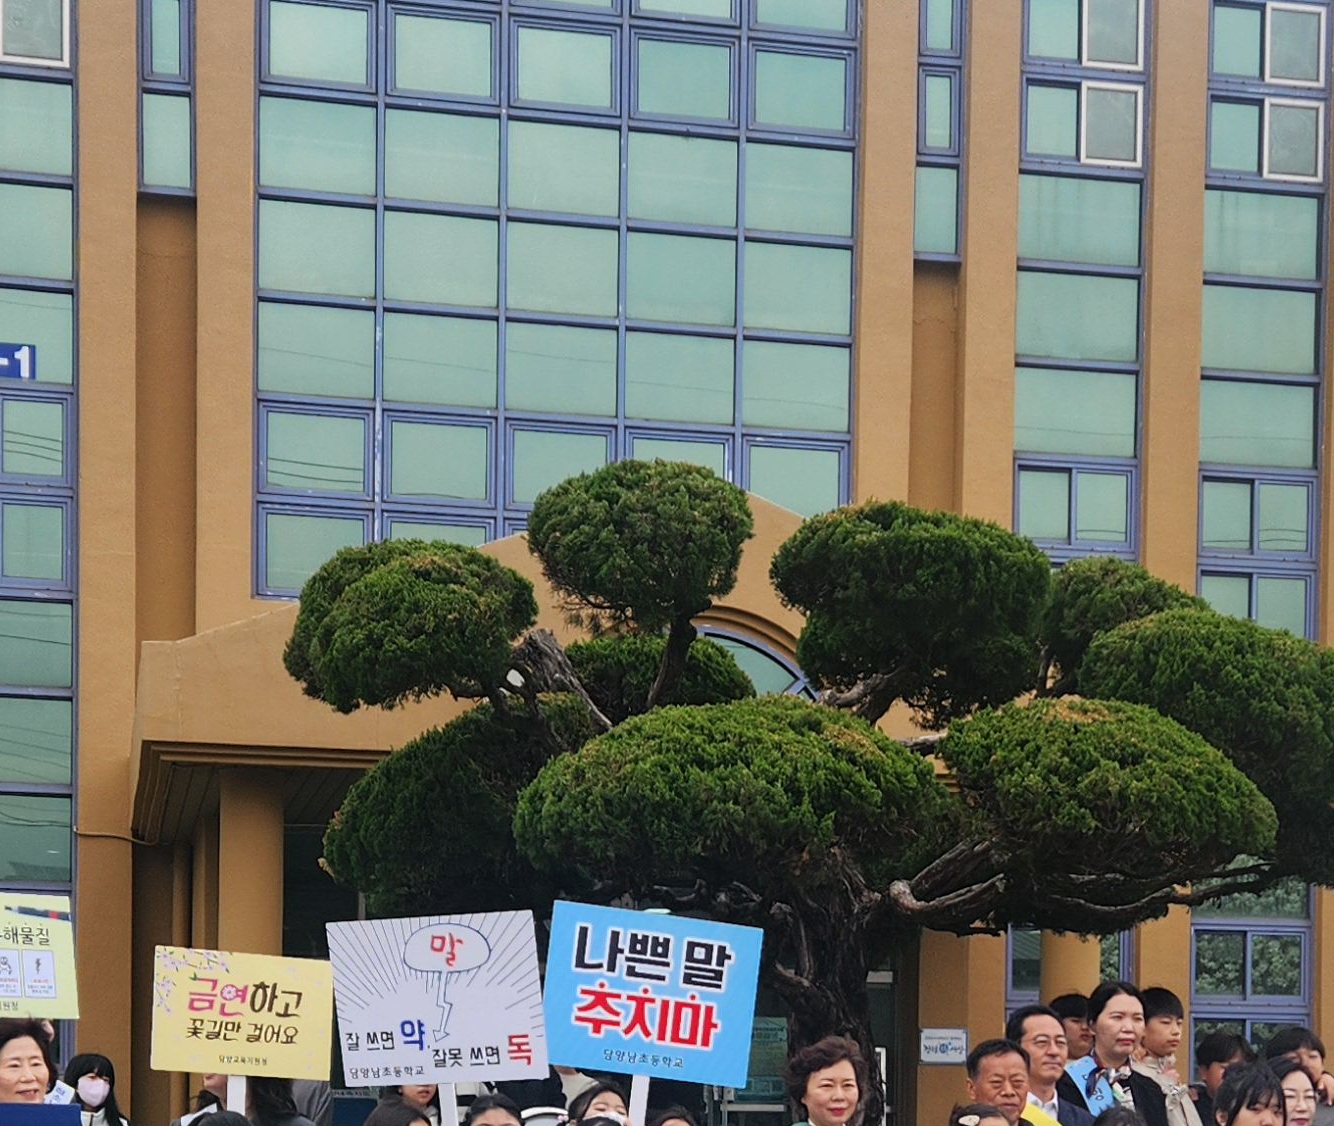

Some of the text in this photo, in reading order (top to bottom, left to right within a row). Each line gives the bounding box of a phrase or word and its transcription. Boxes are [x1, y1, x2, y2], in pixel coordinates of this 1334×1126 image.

[429, 932, 463, 967] 말
[574, 925, 732, 990] 나쁜 말
[188, 976, 303, 1018] 금연하고
[186, 1017, 299, 1045] 꽃길만 걸어요
[346, 1032, 360, 1052] 잘
[366, 1031, 395, 1051] 쓰면
[432, 1033, 532, 1068] 잘못 쓰면 독
[603, 1049, 684, 1068] 담양남초등학교
[349, 1065, 425, 1079] 담양남초등학교
